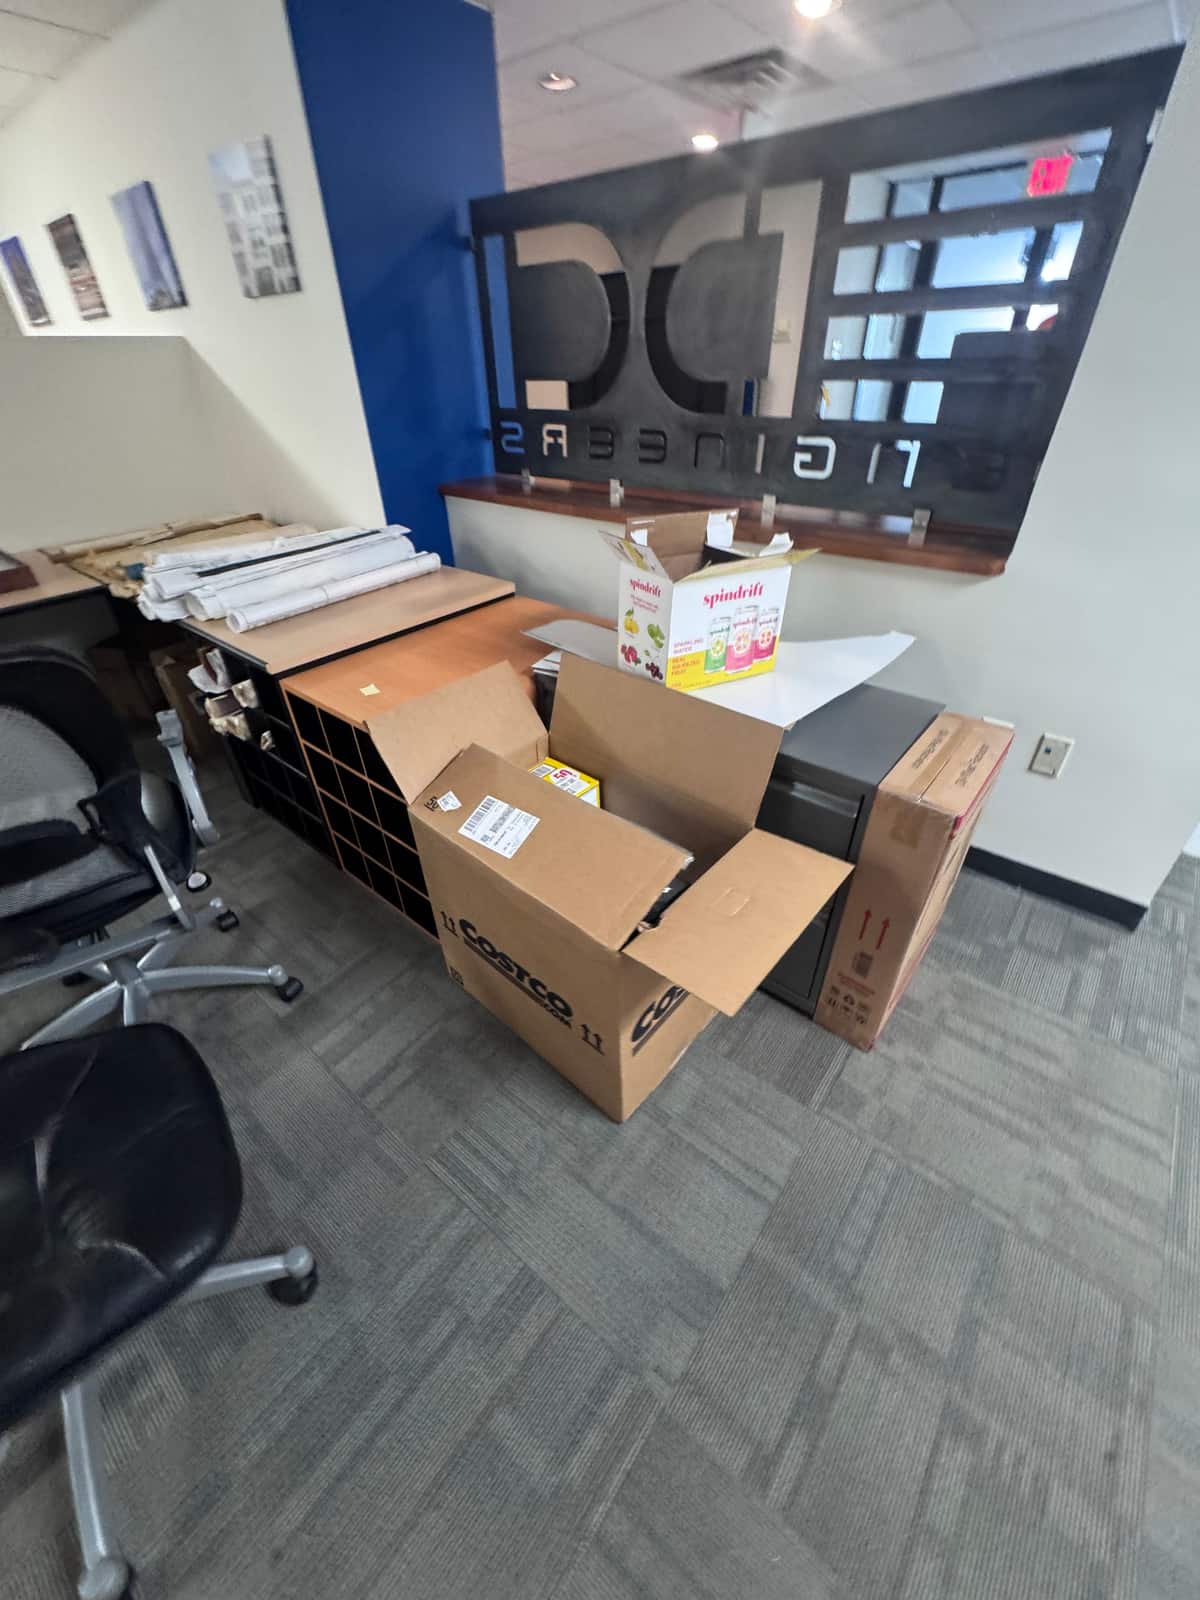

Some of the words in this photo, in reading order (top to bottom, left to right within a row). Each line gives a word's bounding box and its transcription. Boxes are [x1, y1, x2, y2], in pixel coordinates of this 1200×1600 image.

[630, 578, 661, 598] spindrift
[703, 581, 763, 609] spindrift
[459, 918, 573, 1018] COSTCO
